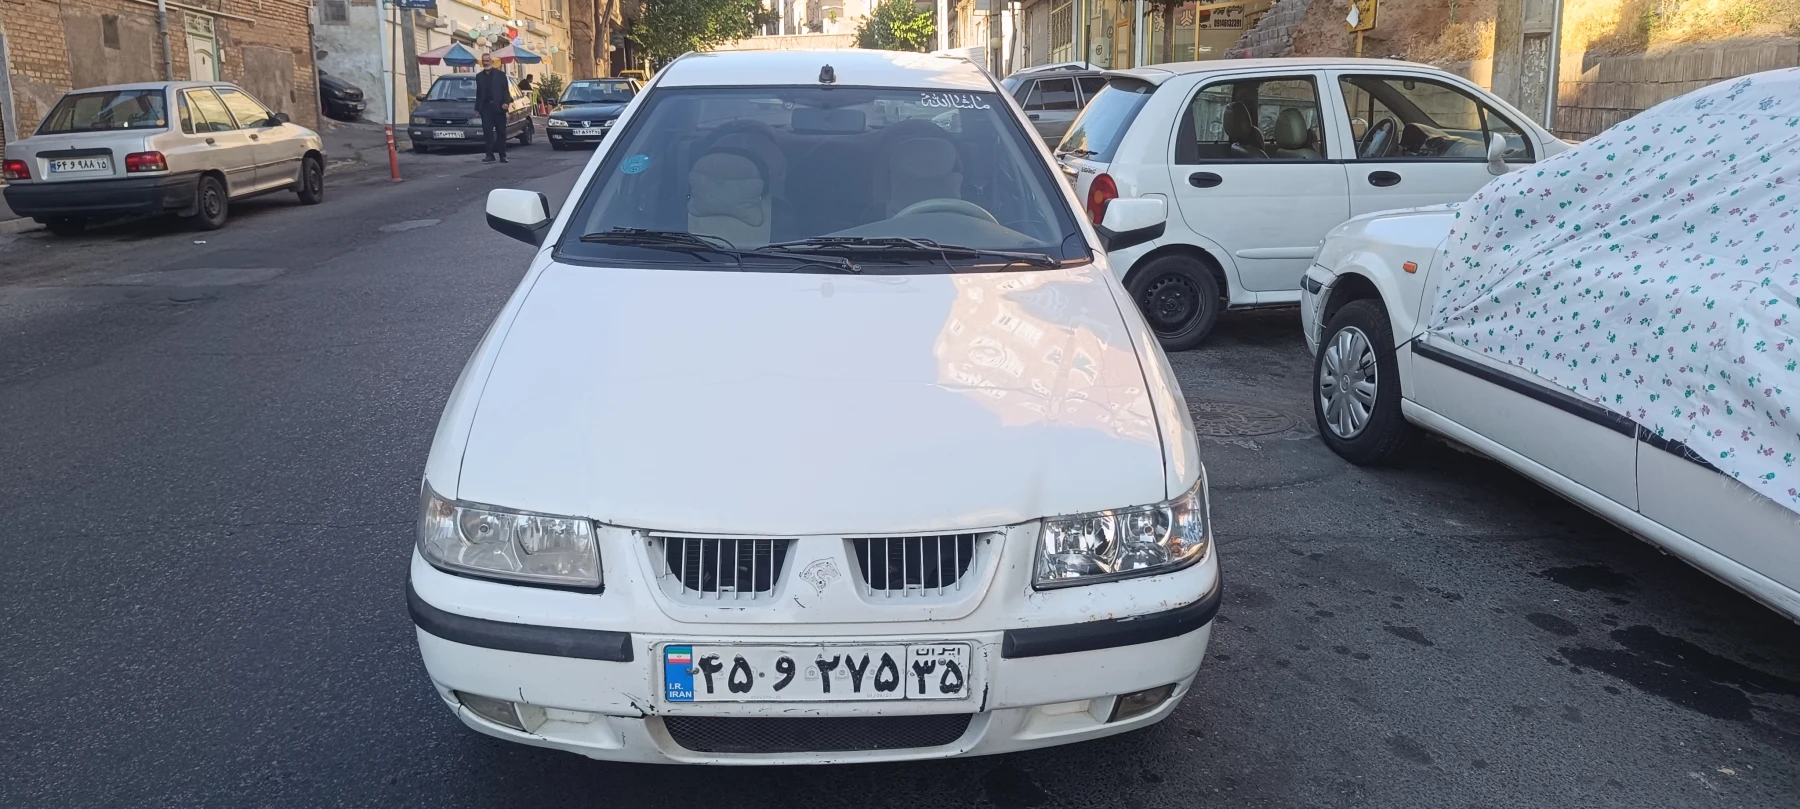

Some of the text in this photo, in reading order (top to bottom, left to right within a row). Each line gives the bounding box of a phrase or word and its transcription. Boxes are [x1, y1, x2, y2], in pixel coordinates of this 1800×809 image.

[78, 160, 94, 169] ۹۸۸
[916, 648, 960, 656] ایران
[698, 652, 963, 694] ۴۵ و ۲۷۵ ۳۵
[669, 682, 684, 690] I.R.
